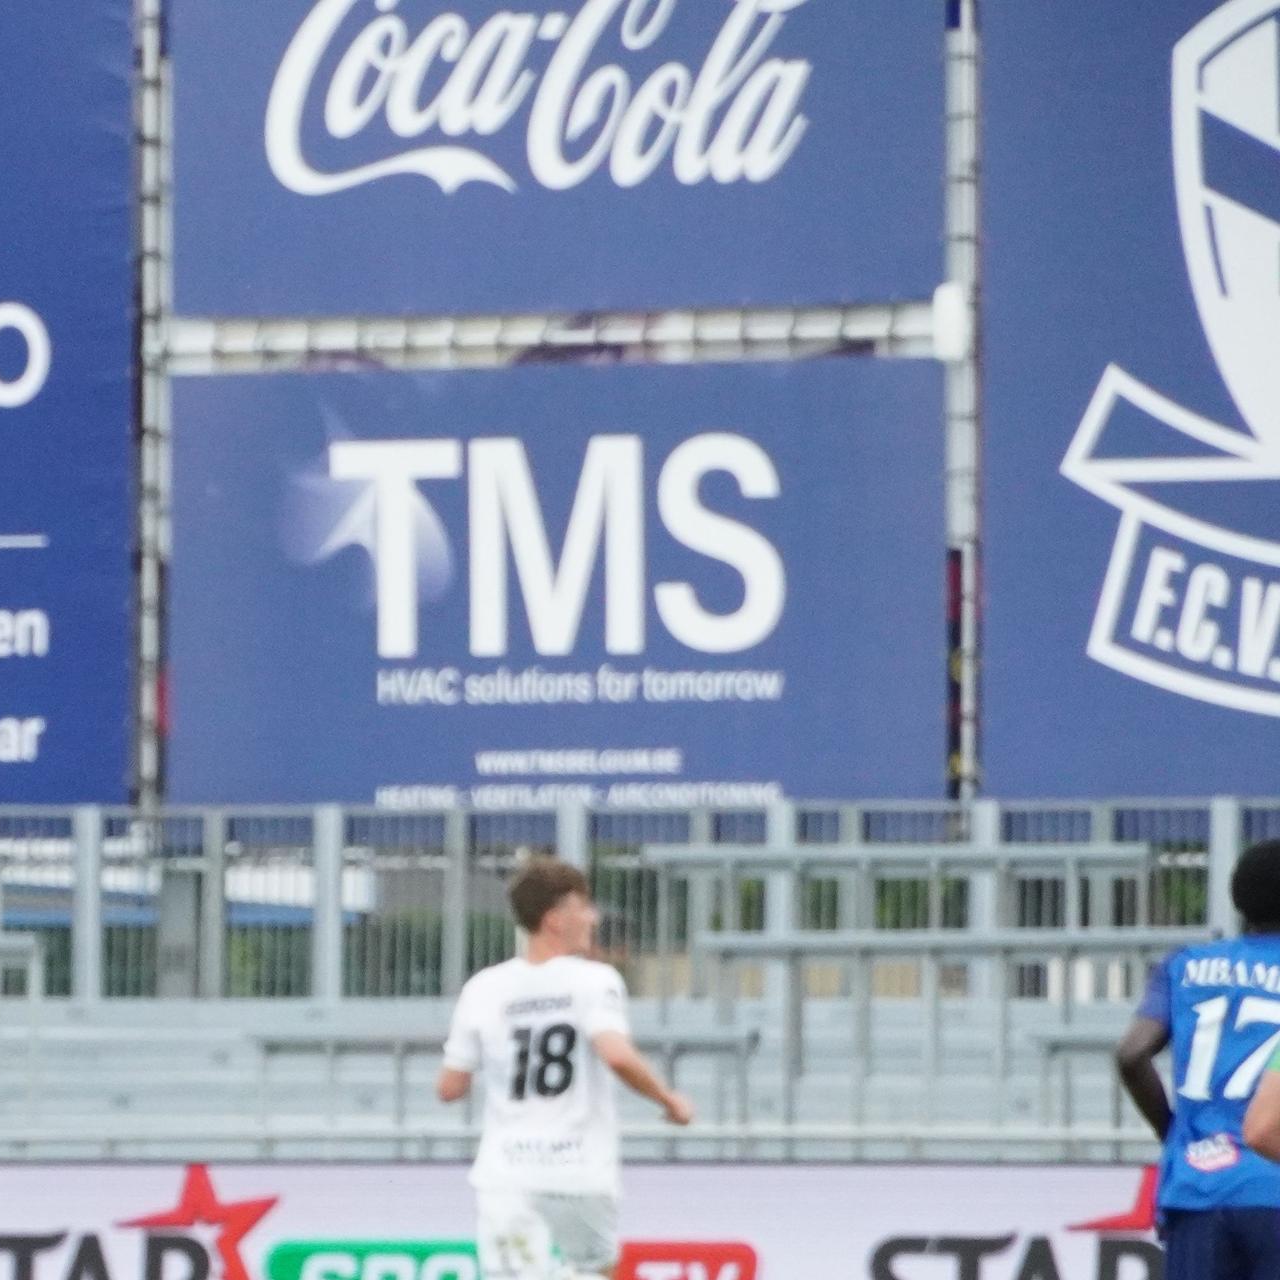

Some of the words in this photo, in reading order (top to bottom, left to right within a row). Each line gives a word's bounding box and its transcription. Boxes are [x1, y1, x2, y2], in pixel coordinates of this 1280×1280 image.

[264, 0, 813, 196] Coca-Cola
[329, 431, 787, 659] TMS
[377, 667, 462, 705] HVAC
[464, 665, 595, 704] solutions
[597, 664, 640, 702] for
[642, 670, 785, 701] tomorrow
[510, 1023, 576, 1100] 18
[1177, 996, 1280, 1100] 17
